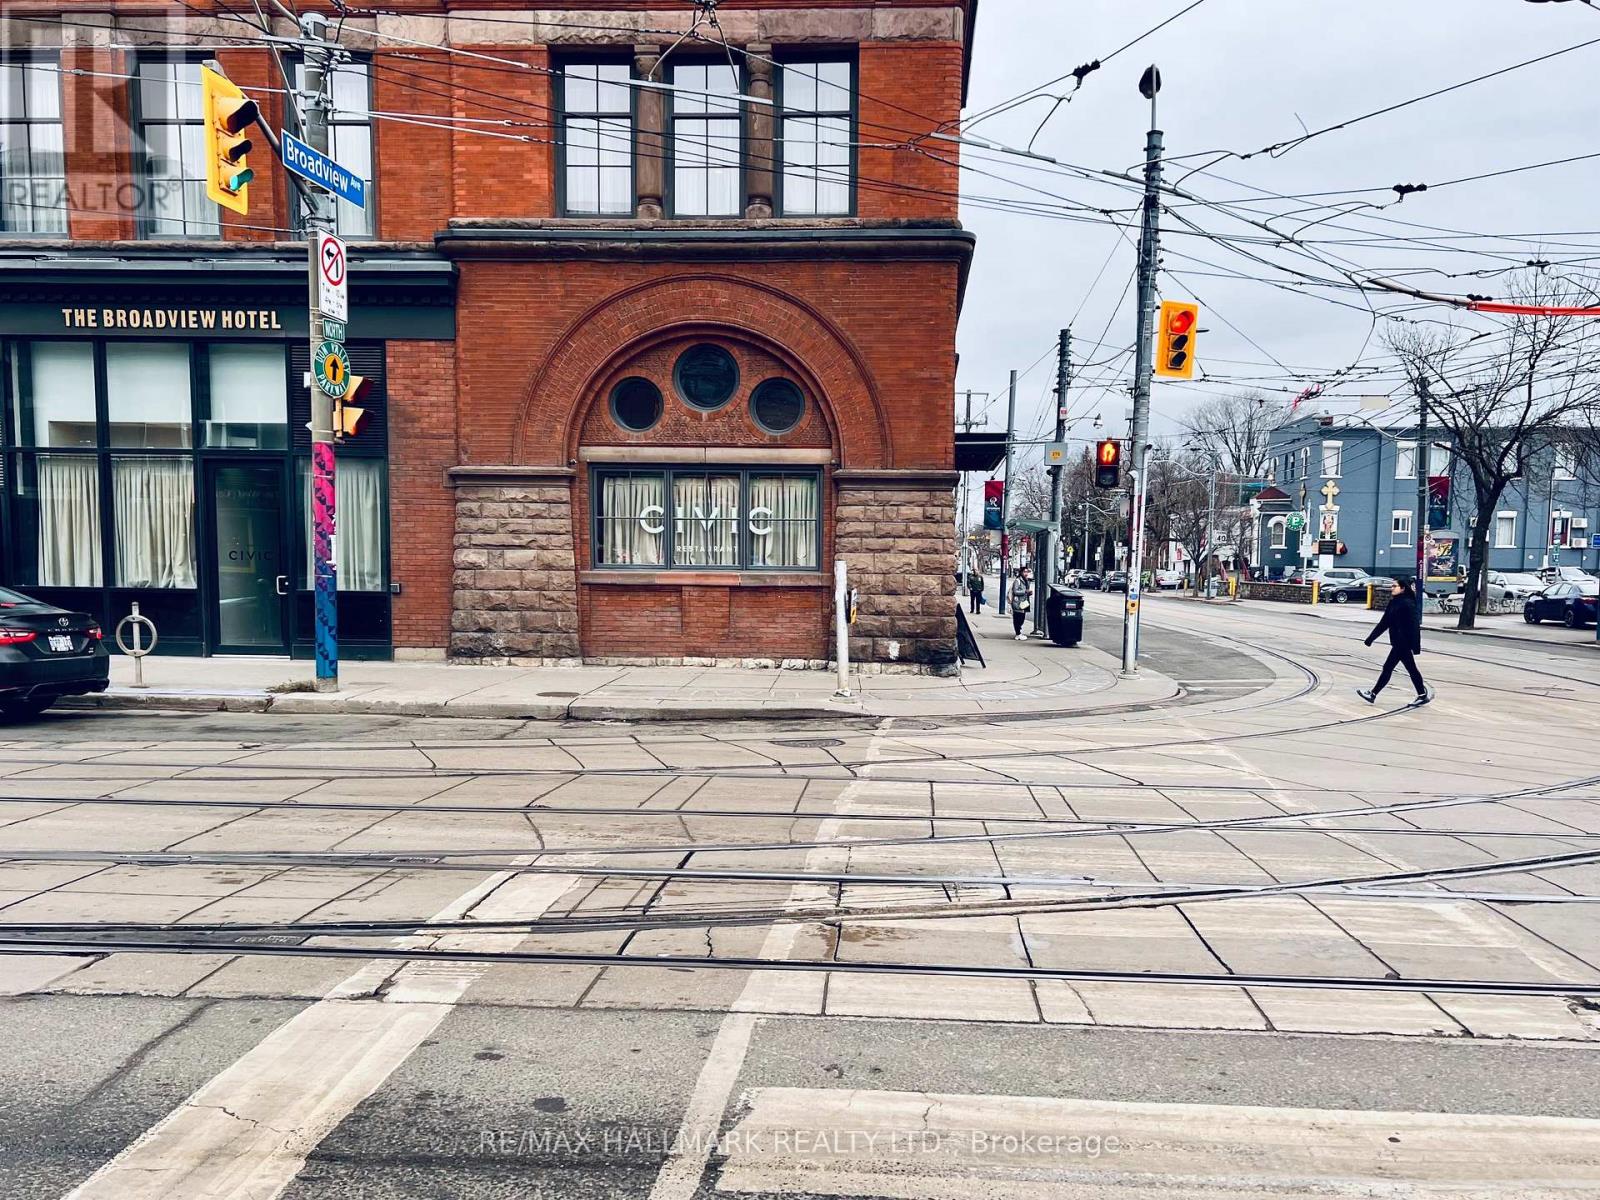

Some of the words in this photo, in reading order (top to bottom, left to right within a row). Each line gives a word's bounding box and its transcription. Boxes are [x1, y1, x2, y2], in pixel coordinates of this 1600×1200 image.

[286, 136, 349, 193] Broadview
[62, 308, 98, 327] THE
[102, 309, 217, 329] BROADVIEW
[221, 310, 282, 330] HOTEL
[325, 321, 343, 340] NORTH
[316, 345, 329, 363] DON
[331, 343, 350, 373] VALLEY
[317, 374, 347, 396] PARKWAY
[639, 505, 773, 535] CIVIC
[228, 550, 273, 561] CIVIC
